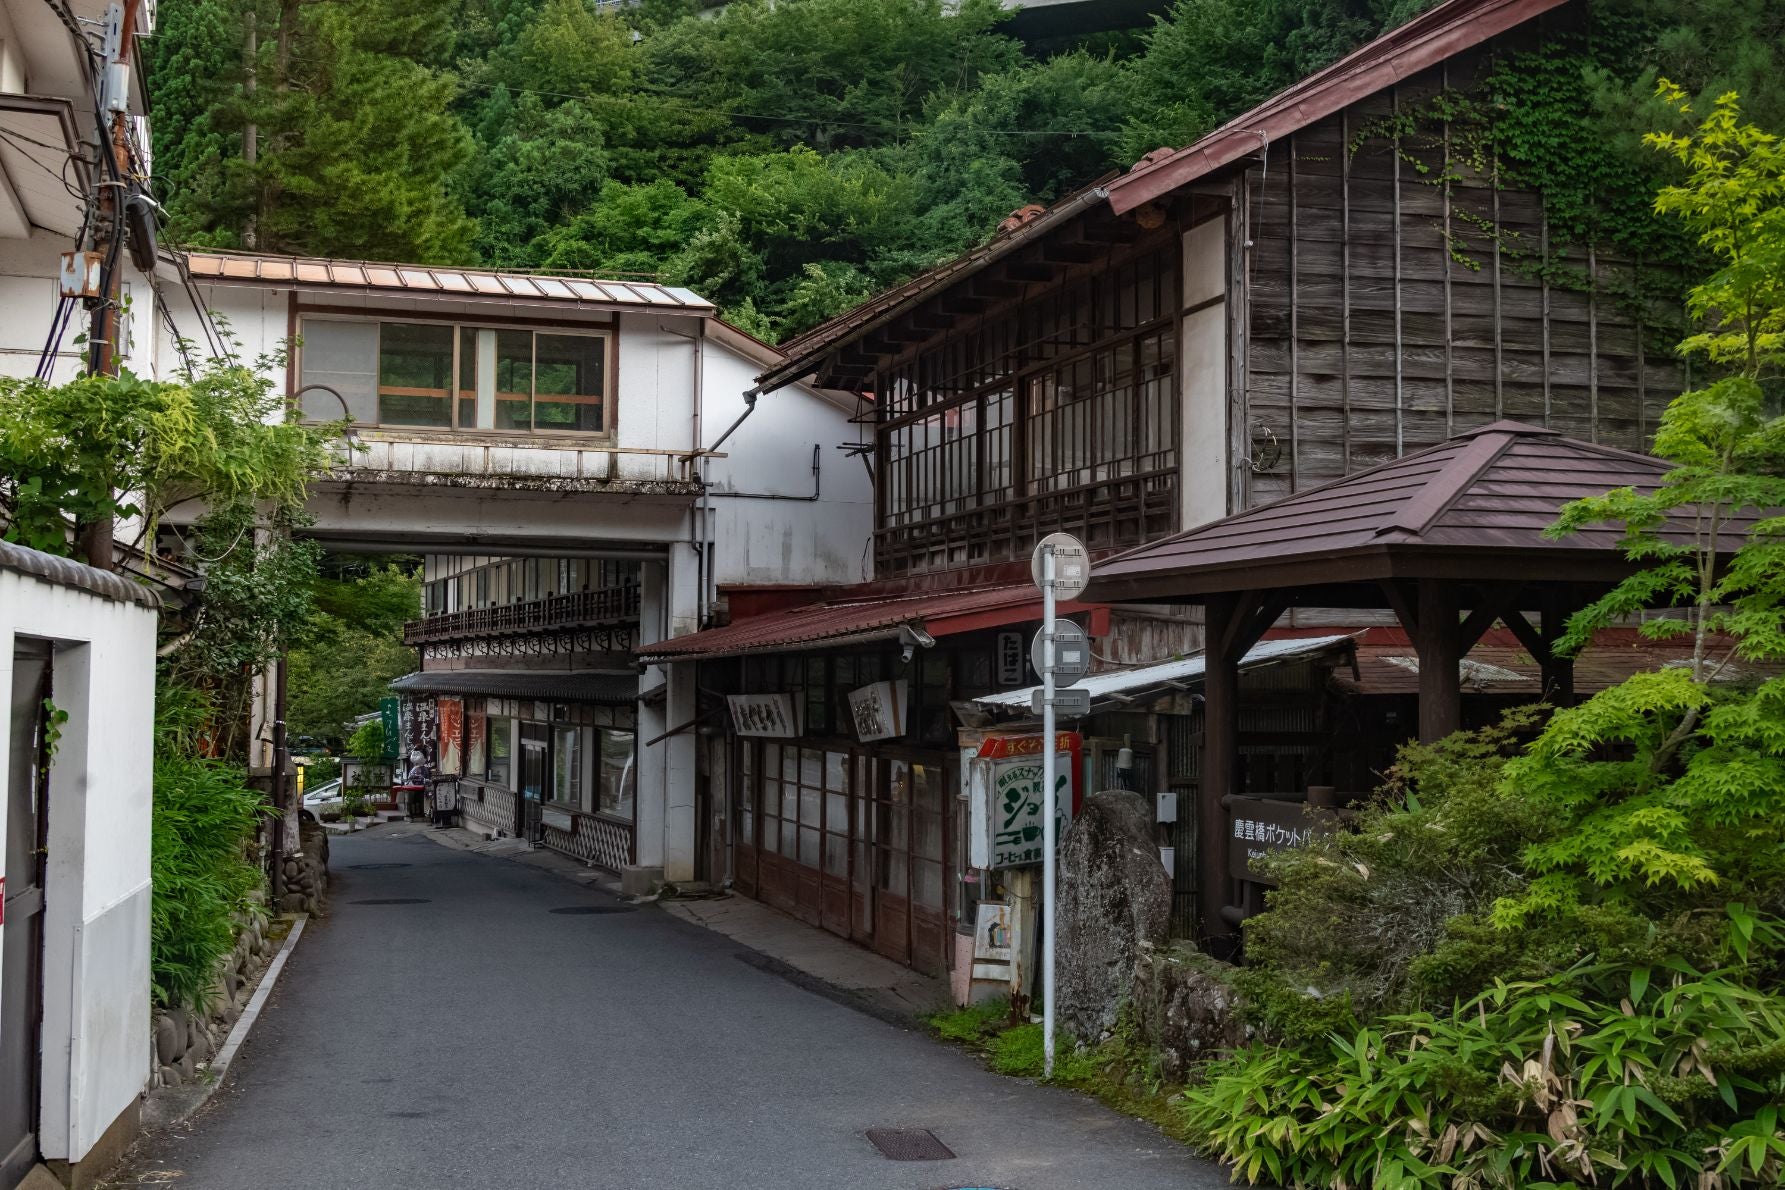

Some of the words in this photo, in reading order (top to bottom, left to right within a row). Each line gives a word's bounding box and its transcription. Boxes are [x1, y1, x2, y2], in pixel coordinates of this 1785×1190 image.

[403, 703, 415, 753] 温泉まんじゅ
